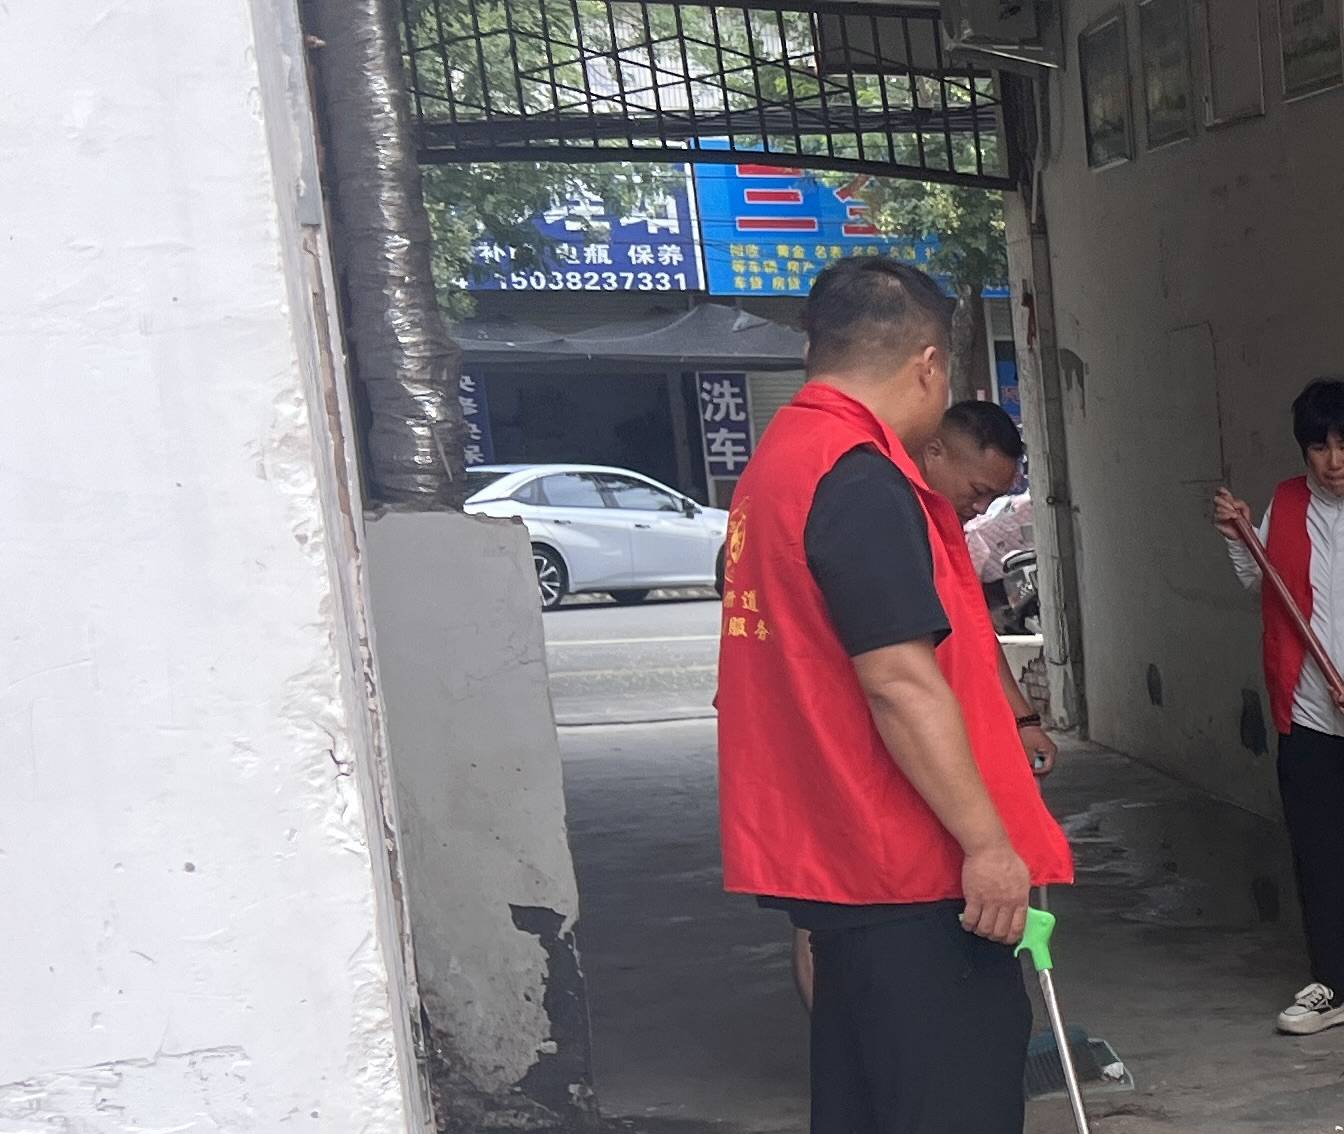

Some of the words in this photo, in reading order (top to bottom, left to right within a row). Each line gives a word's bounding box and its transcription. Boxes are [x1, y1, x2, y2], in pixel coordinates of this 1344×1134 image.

[628, 243, 684, 265] 保养
[494, 272, 688, 290] 15038237331
[701, 380, 748, 471] 洗车
